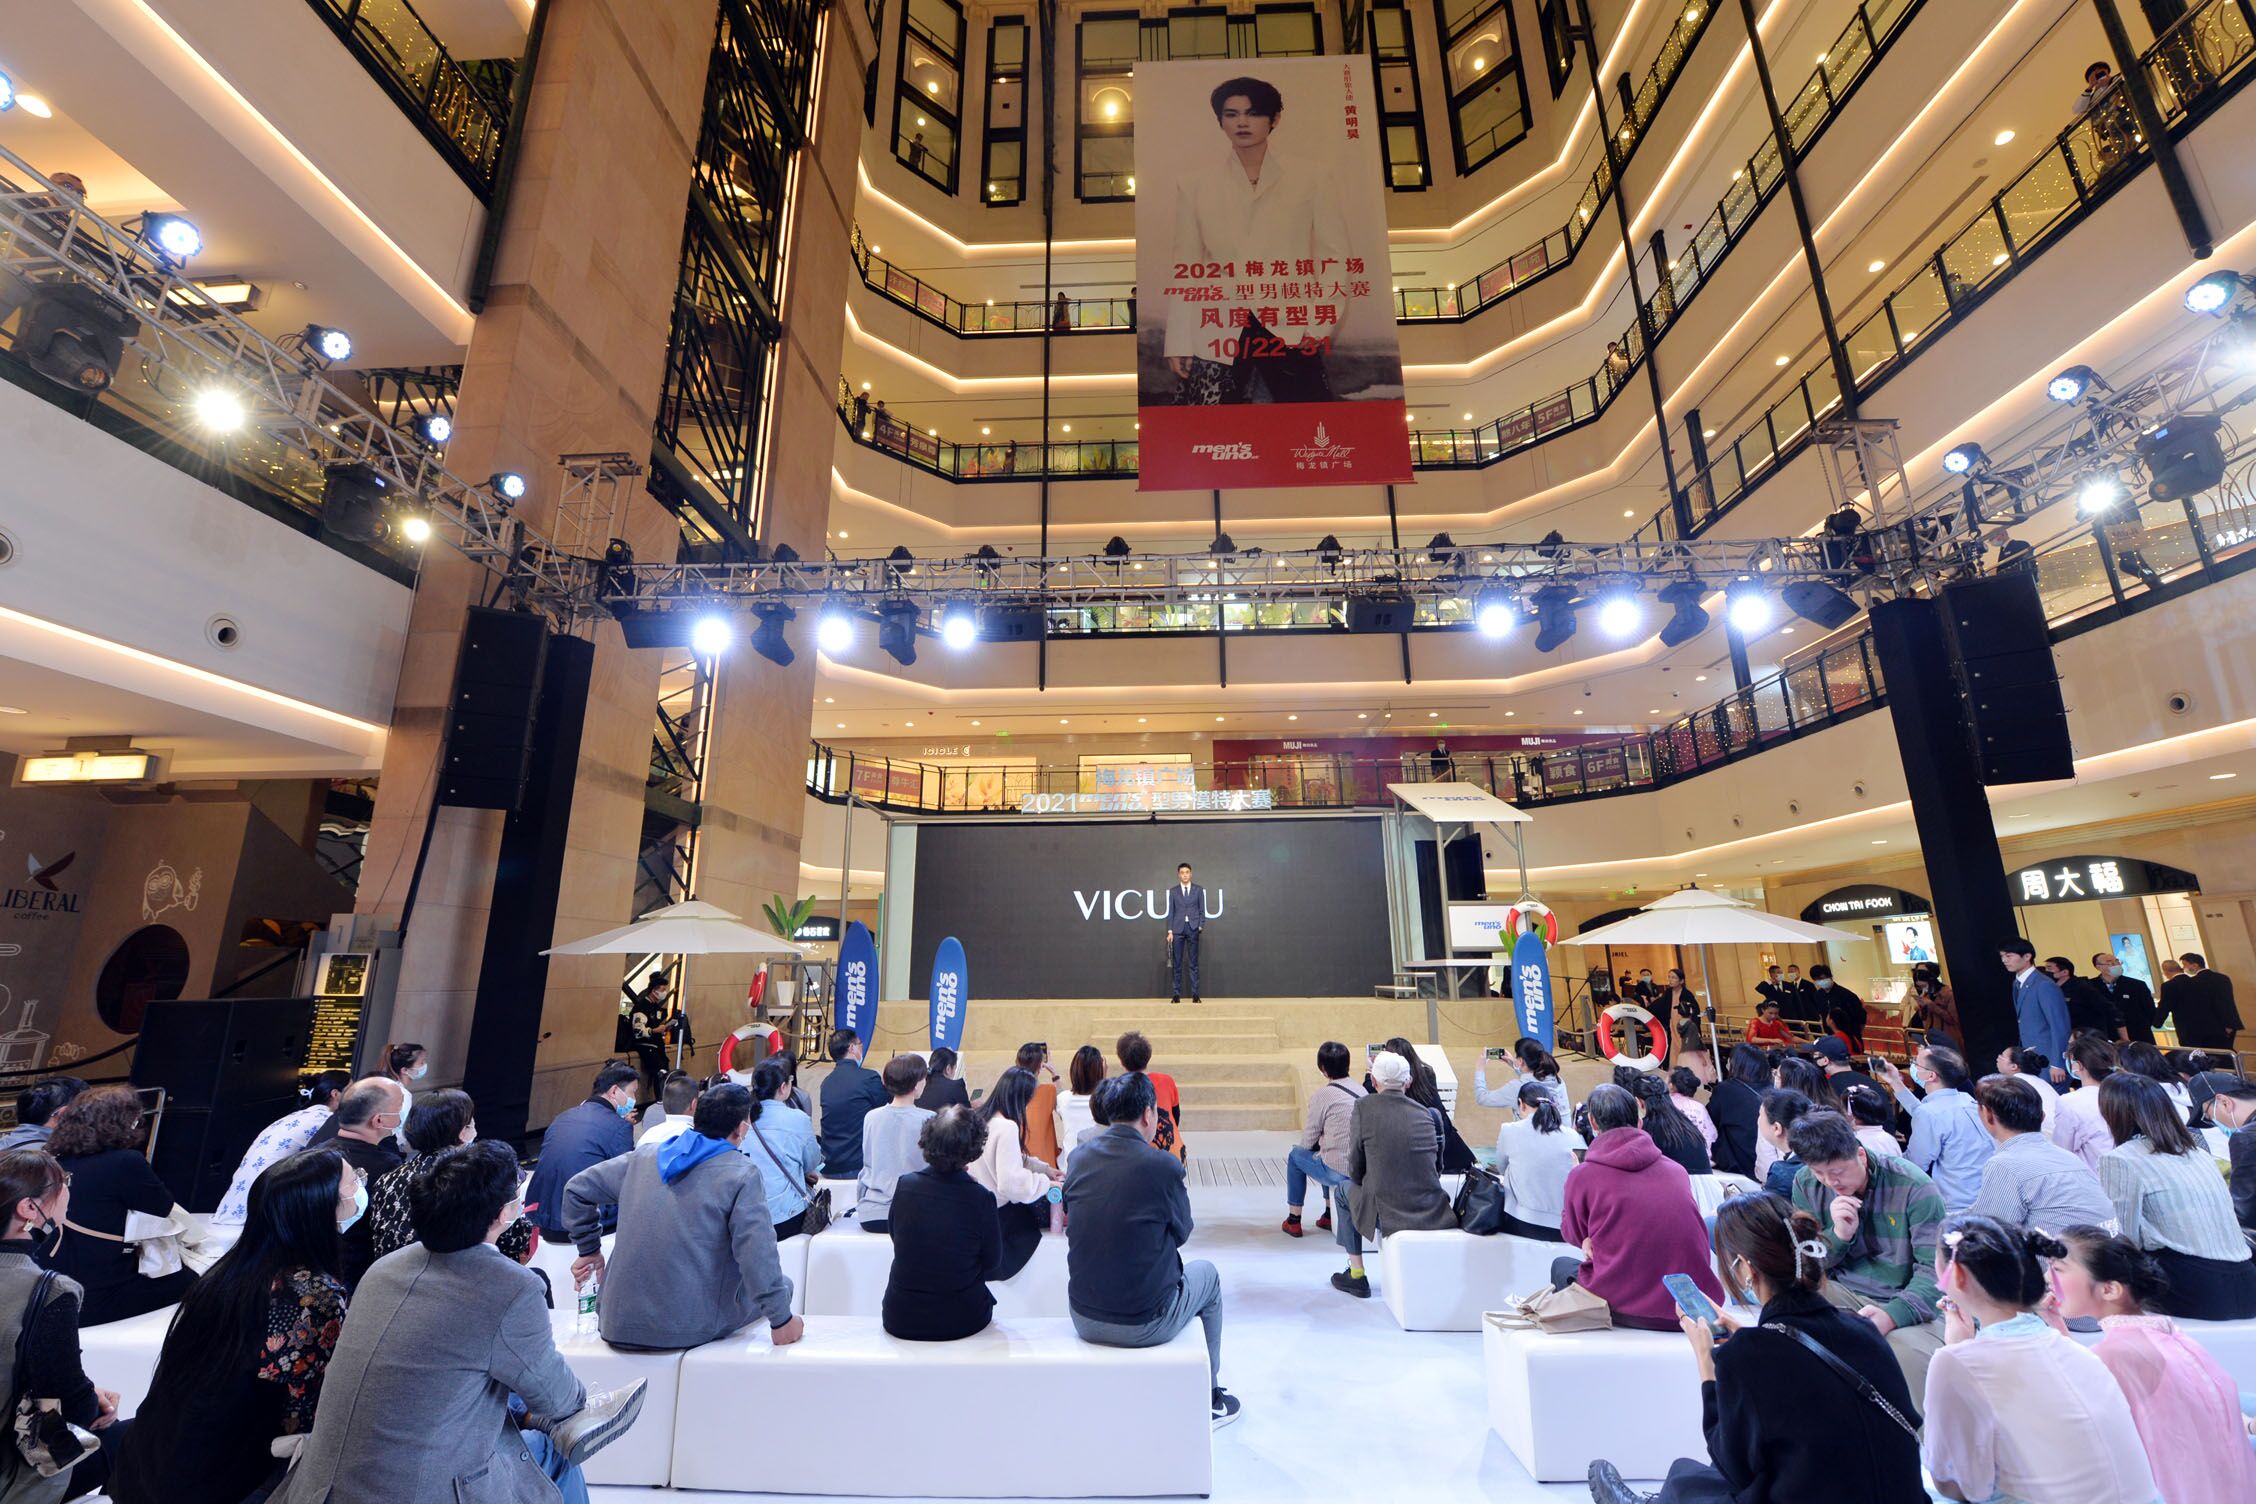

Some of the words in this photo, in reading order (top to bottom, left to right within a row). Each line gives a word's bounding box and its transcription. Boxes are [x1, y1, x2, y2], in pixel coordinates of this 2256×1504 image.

[1344, 105, 1359, 139] 黄明昊
[1174, 263, 1234, 279] 2021
[1245, 258, 1365, 277] 梅龙镇广场
[1163, 284, 1223, 296] men's
[1183, 293, 1224, 302] uno
[1236, 280, 1372, 300] 型男模特大赛
[1200, 304, 1338, 329] 风度有型男
[1208, 336, 1333, 359] 10/22-31
[1538, 409, 1553, 423] 5F
[1191, 441, 1252, 454] men's
[1211, 451, 1253, 461] uno
[1296, 461, 1352, 470] 梅龙镇广场
[1283, 741, 1302, 749] MUJI
[1521, 737, 1541, 746] MUJI
[923, 747, 959, 756] ICICLE
[856, 769, 871, 782] 7F
[1587, 760, 1604, 774] 6F
[1096, 767, 1195, 786] 梅龙镇广场
[1022, 793, 1078, 814] 2021
[1151, 789, 1271, 811] 型男模特大赛
[2020, 861, 2124, 900] 周大福
[0, 888, 80, 913] IBERAL
[1073, 888, 1224, 921] VICUU
[1823, 901, 1849, 913] CHOW
[1848, 899, 1864, 910] TAI
[1865, 897, 1893, 909] FOOK
[14, 911, 49, 920] coffee
[846, 961, 858, 1028] men's
[854, 960, 866, 1007] uno
[1519, 965, 1539, 1034] men's
[1530, 964, 1546, 1011] uno
[935, 972, 950, 1040] men's
[943, 972, 958, 1018] uno
